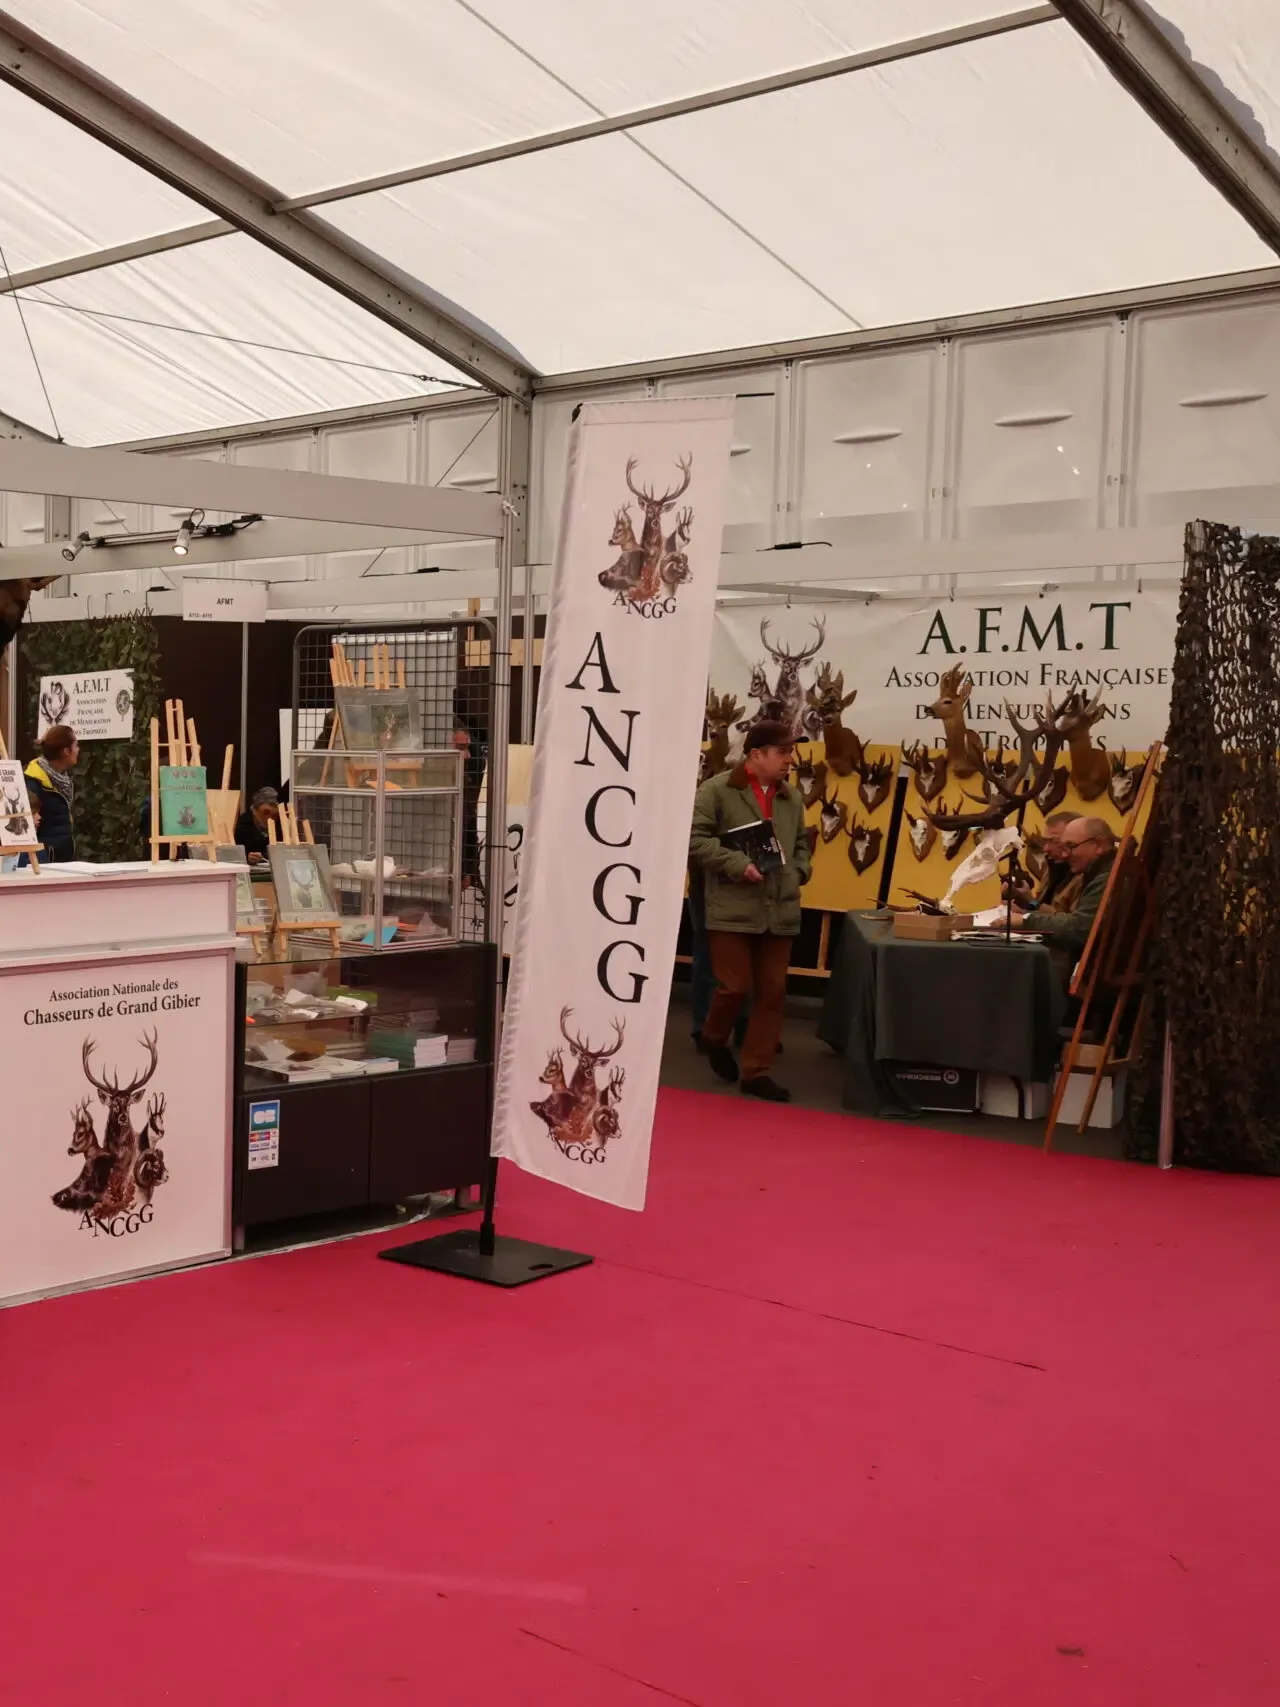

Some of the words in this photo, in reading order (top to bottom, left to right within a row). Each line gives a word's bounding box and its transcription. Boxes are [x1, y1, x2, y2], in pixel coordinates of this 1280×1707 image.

[611, 589, 677, 619] ANCGG
[916, 601, 1132, 655] A.F.M.T
[72, 677, 112, 695] A.F.M.T
[884, 665, 1030, 688] ASSOATION
[1039, 663, 1169, 690] FRANÇAISE
[565, 631, 650, 1004] ANCGG
[49, 985, 110, 1002] Association
[112, 979, 161, 996] Nationale
[162, 977, 179, 990] des
[23, 1007, 94, 1026] Chasseurs
[97, 1002, 114, 1018] de
[116, 997, 158, 1016] Grand
[161, 993, 201, 1010] Gibier
[78, 1203, 155, 1238] ANCGG
